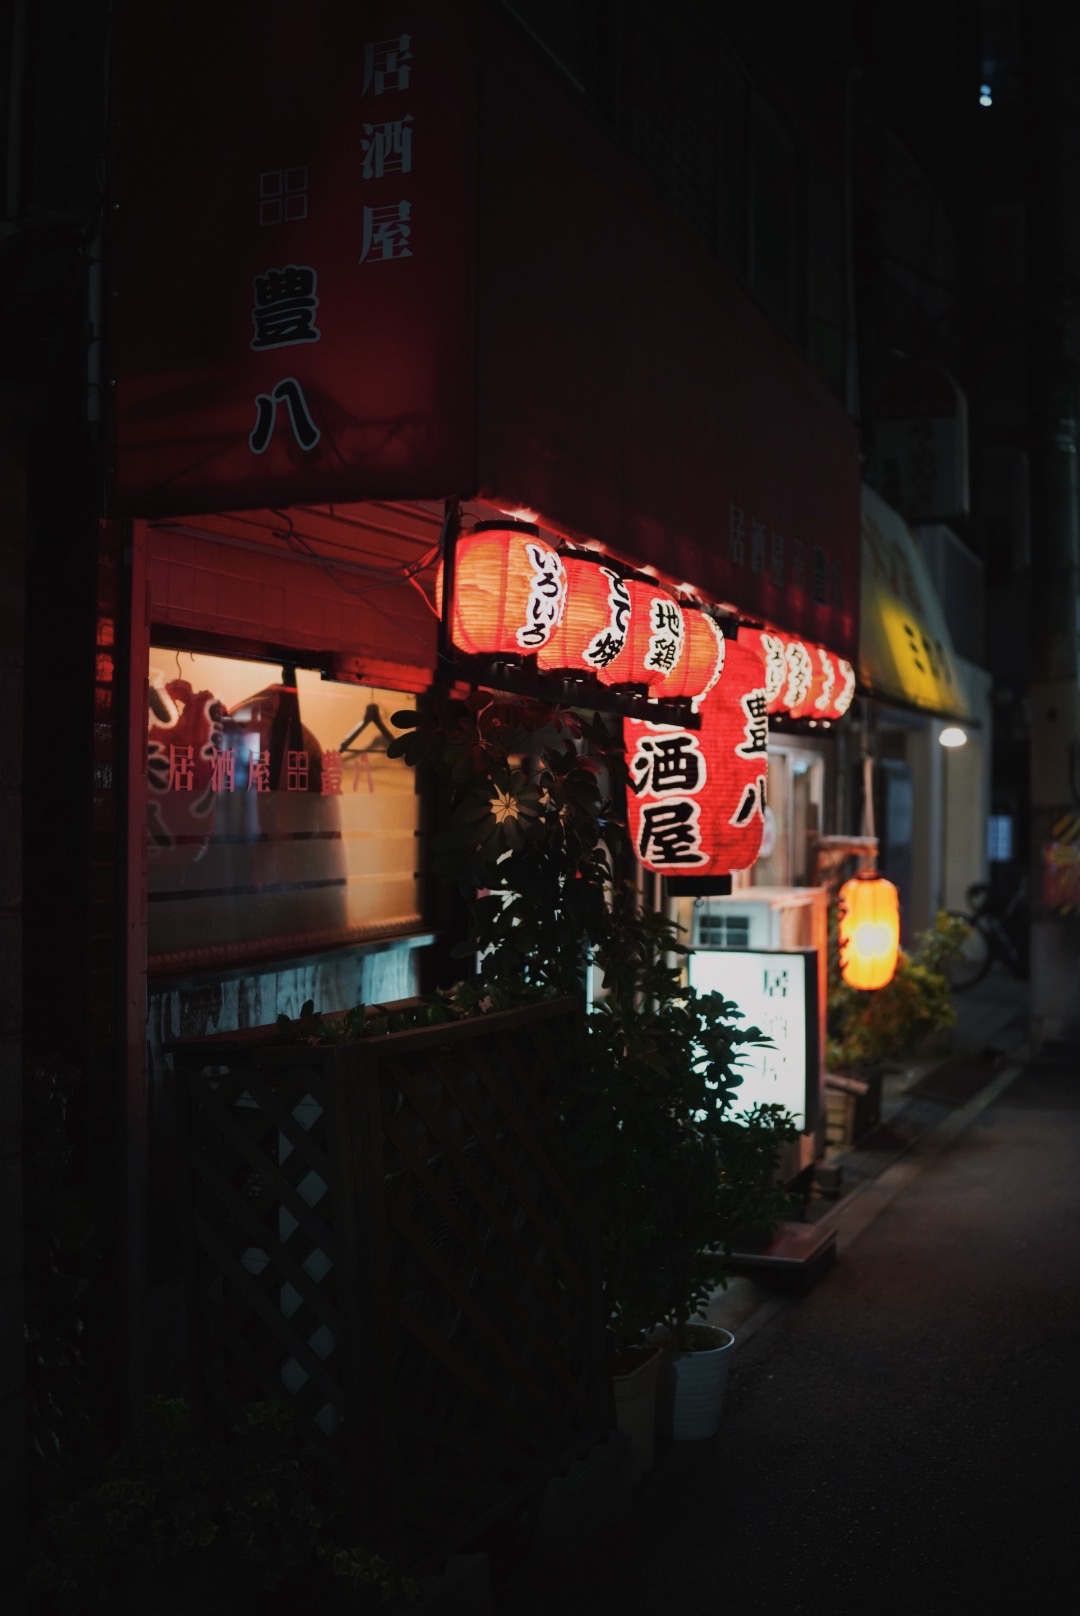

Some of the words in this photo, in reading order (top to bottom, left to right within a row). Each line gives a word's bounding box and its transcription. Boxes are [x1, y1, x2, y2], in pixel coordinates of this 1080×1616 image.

[359, 33, 415, 264] 居酒屋
[249, 264, 322, 454] 豊八
[519, 546, 562, 648] いろいろ
[647, 600, 682, 674] 地鶏
[167, 744, 271, 793] 居酒屋
[632, 720, 708, 866] 酒屋
